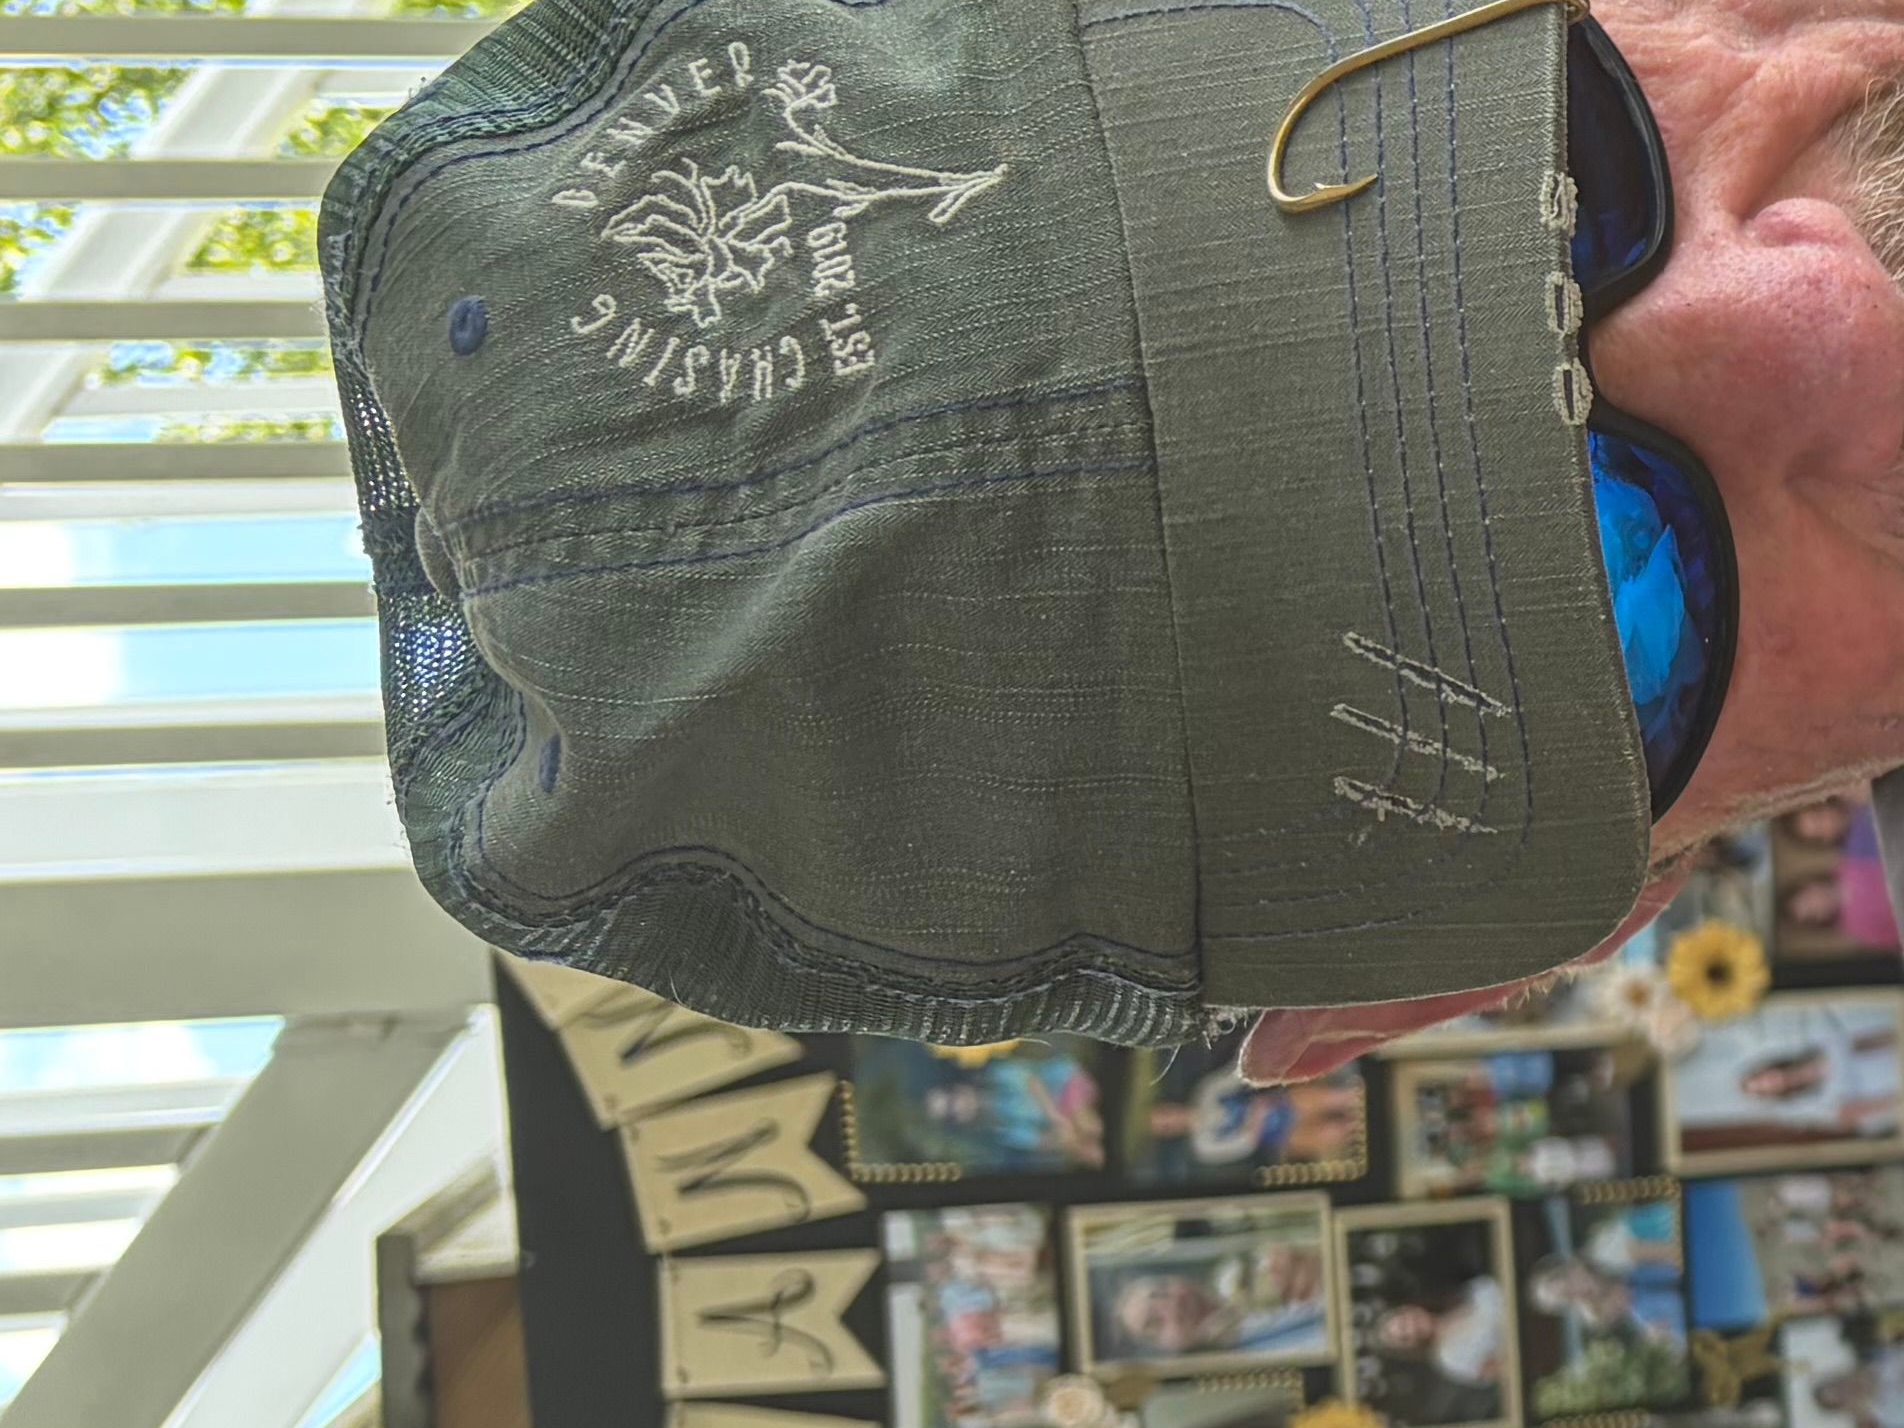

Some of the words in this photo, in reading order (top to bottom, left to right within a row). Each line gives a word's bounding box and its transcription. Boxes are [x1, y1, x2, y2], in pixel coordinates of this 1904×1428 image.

[551, 41, 755, 209] DENVER
[806, 222, 856, 297] 2019
[571, 294, 804, 406] CHASING
[820, 303, 875, 378] EST.
